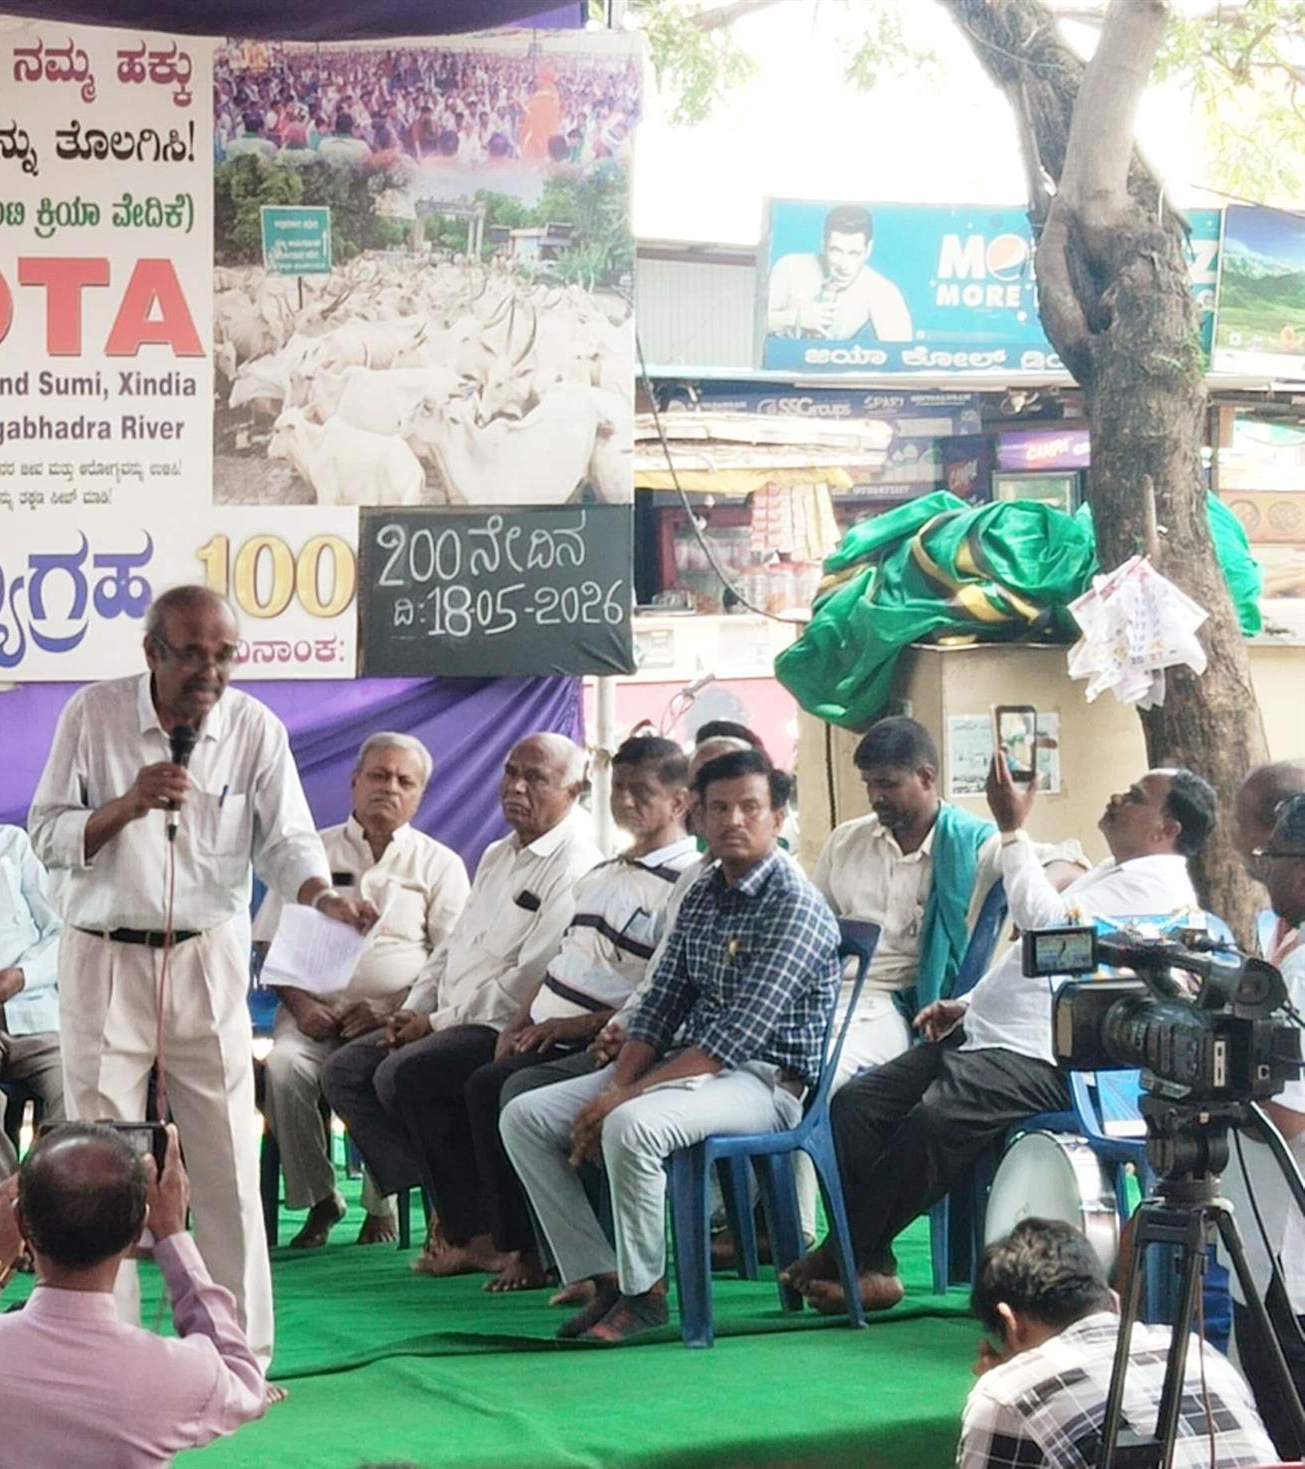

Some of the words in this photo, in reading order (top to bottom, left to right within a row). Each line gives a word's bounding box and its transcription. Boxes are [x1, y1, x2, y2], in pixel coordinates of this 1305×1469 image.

[13, 36, 96, 103] ನಮ್ಮ
[116, 40, 192, 107] ಹಕ್ಕು
[56, 120, 194, 162] ತೊಲಗಿಸಿ!
[34, 196, 100, 239] ಕ್ರಿಯಾ
[112, 192, 194, 234] ವೇದಿಕೆ)
[936, 284, 1021, 307] MORE
[39, 371, 108, 400] Sumi,
[118, 371, 196, 396] Xindia
[122, 415, 184, 440] River
[197, 533, 355, 618] 100
